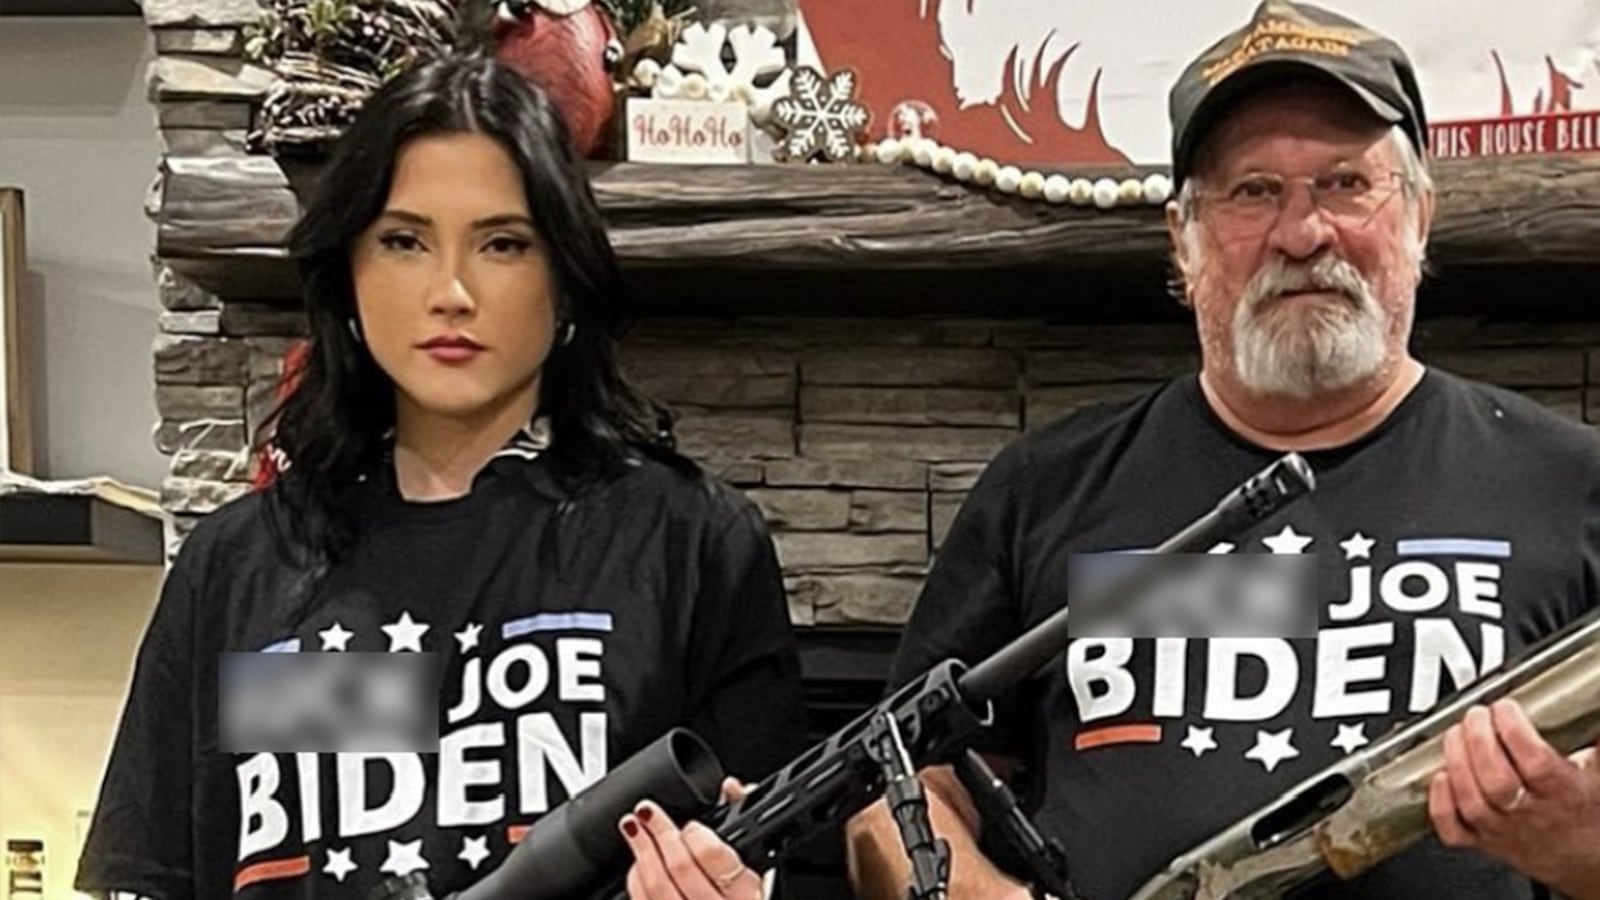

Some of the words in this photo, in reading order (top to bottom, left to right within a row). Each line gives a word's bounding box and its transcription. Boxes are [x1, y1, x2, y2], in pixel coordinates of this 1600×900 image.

[1274, 36, 1349, 57] AGAIN
[1428, 126, 1472, 159] THIS
[1481, 120, 1547, 156] HOUSE
[1328, 560, 1503, 620] JOE
[447, 638, 605, 723] JOE
[1067, 617, 1505, 723] BIDEN
[235, 712, 608, 862] BIDEN
